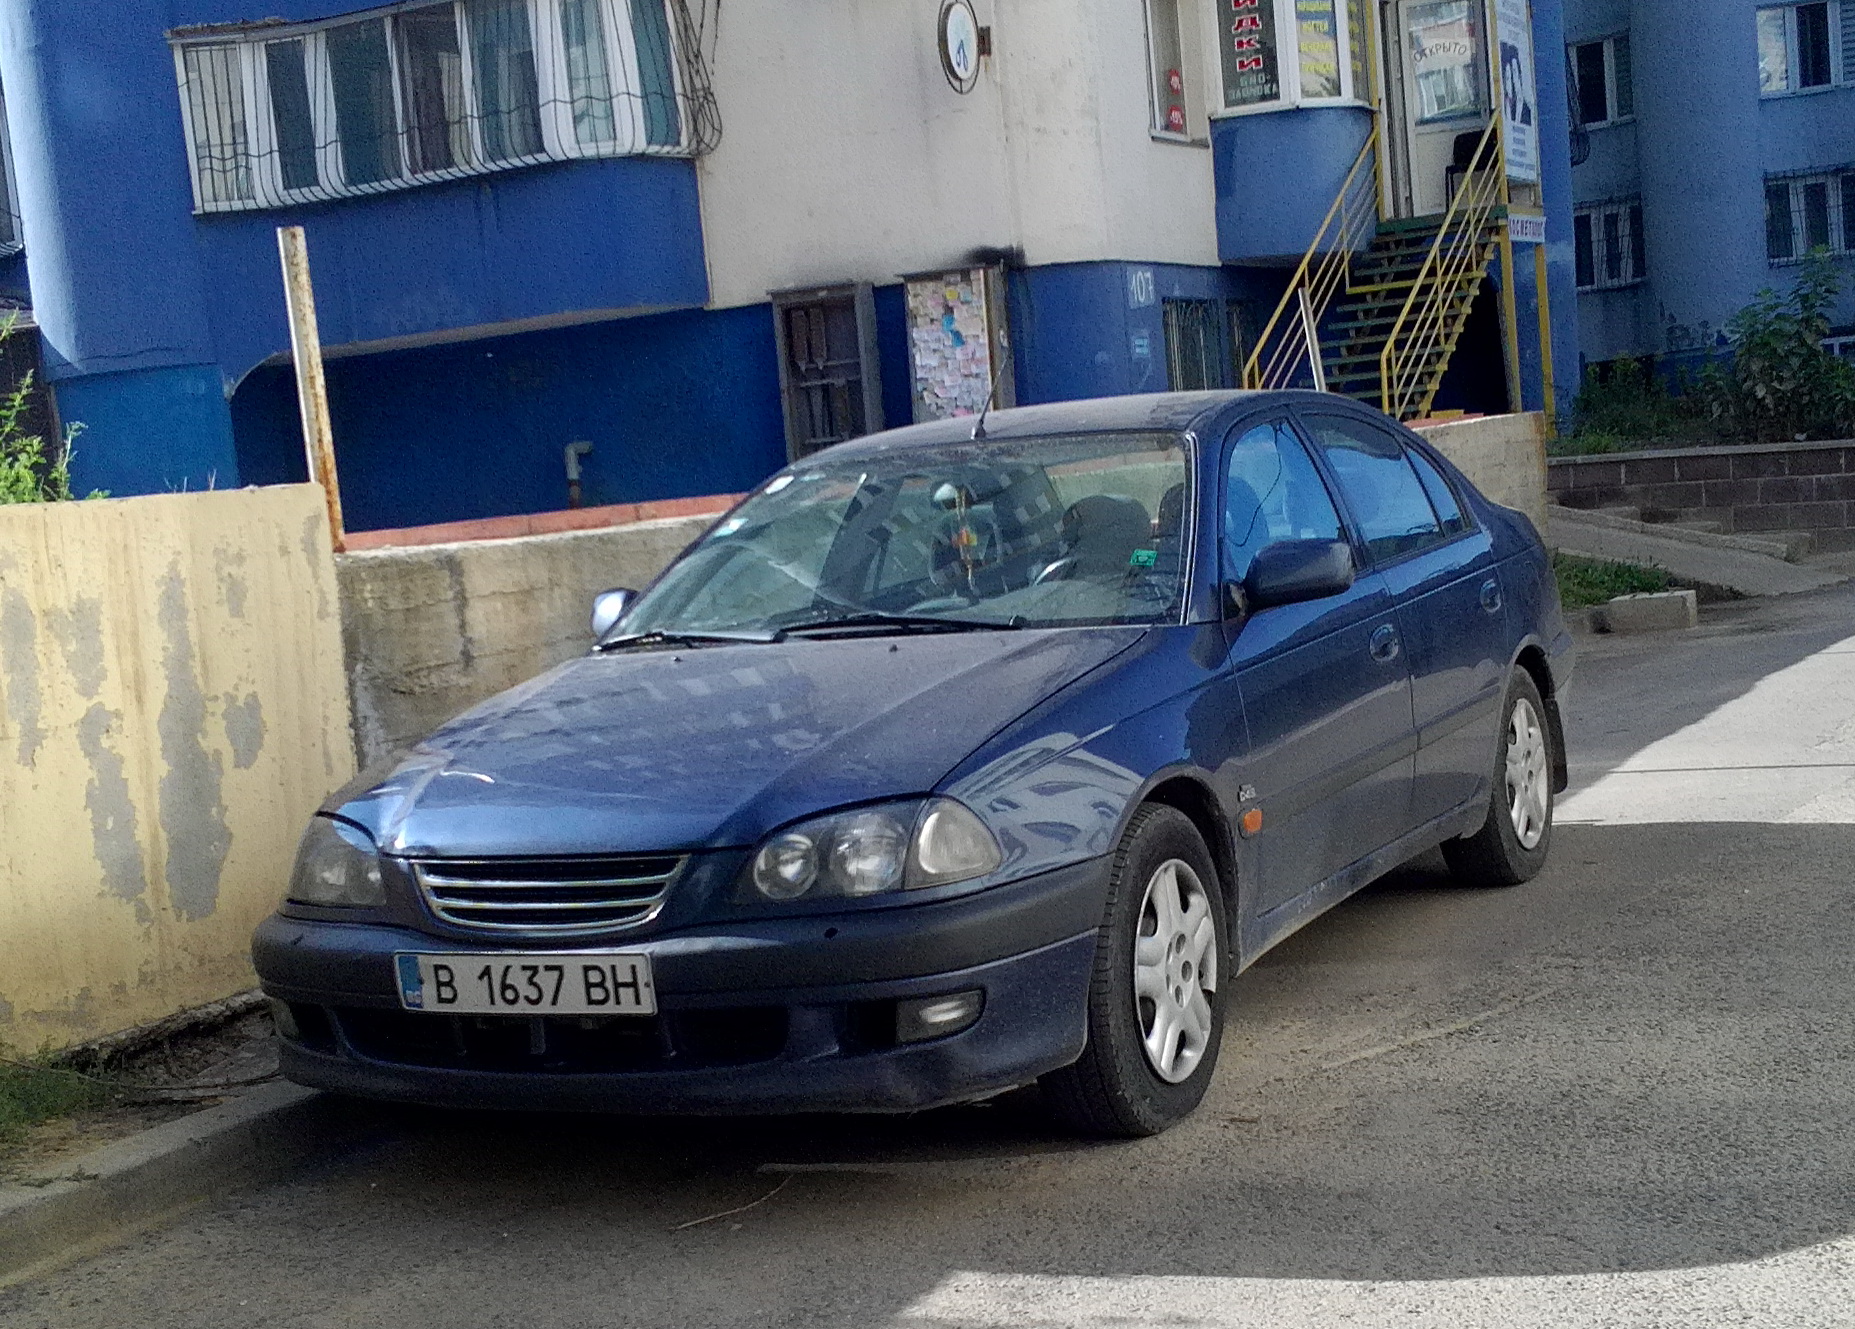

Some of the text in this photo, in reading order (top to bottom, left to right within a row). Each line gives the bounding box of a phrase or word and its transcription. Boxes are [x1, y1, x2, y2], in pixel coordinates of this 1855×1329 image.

[1413, 41, 1467, 62] ОТКРЫТО
[1130, 270, 1154, 303] 107
[477, 963, 565, 1007] 1637
